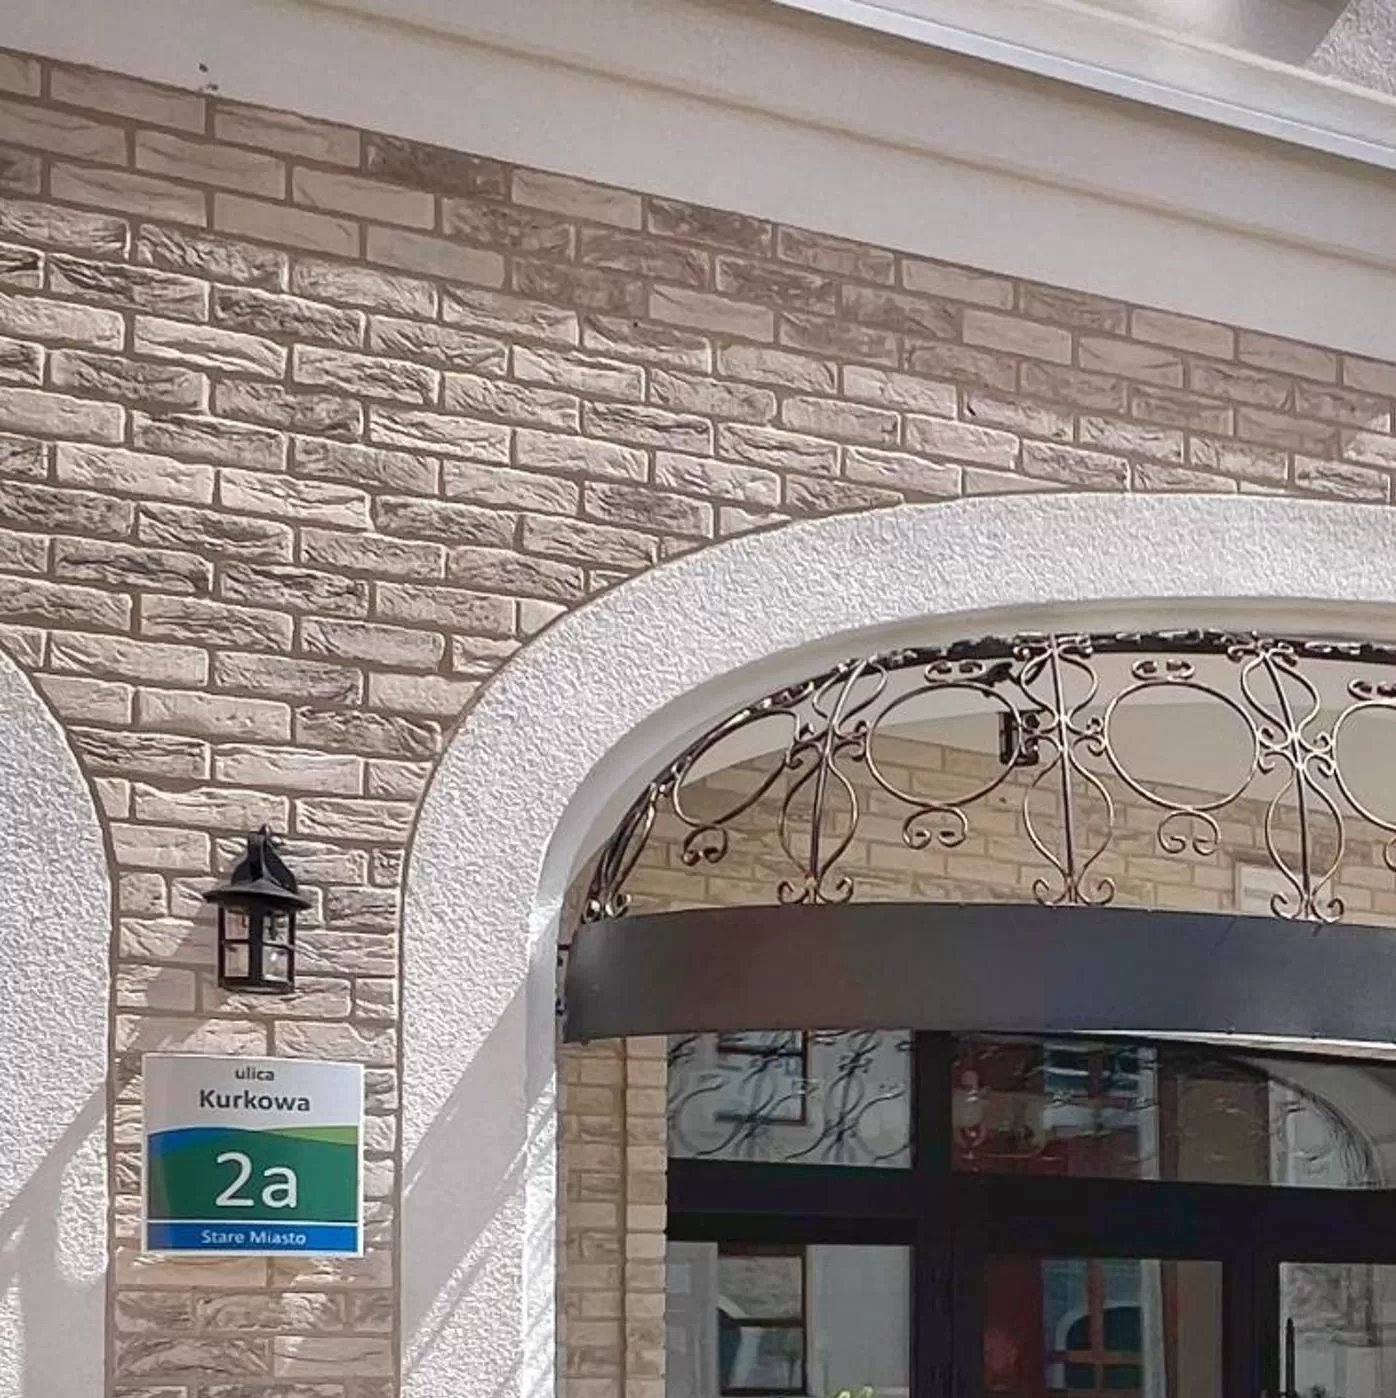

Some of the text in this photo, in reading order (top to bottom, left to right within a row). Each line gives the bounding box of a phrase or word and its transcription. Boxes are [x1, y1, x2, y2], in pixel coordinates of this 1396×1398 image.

[234, 1066, 275, 1082] ulica
[199, 1089, 311, 1112] Kurkowa
[214, 1151, 299, 1209] 2a
[201, 1230, 307, 1246] Stare Miasto
